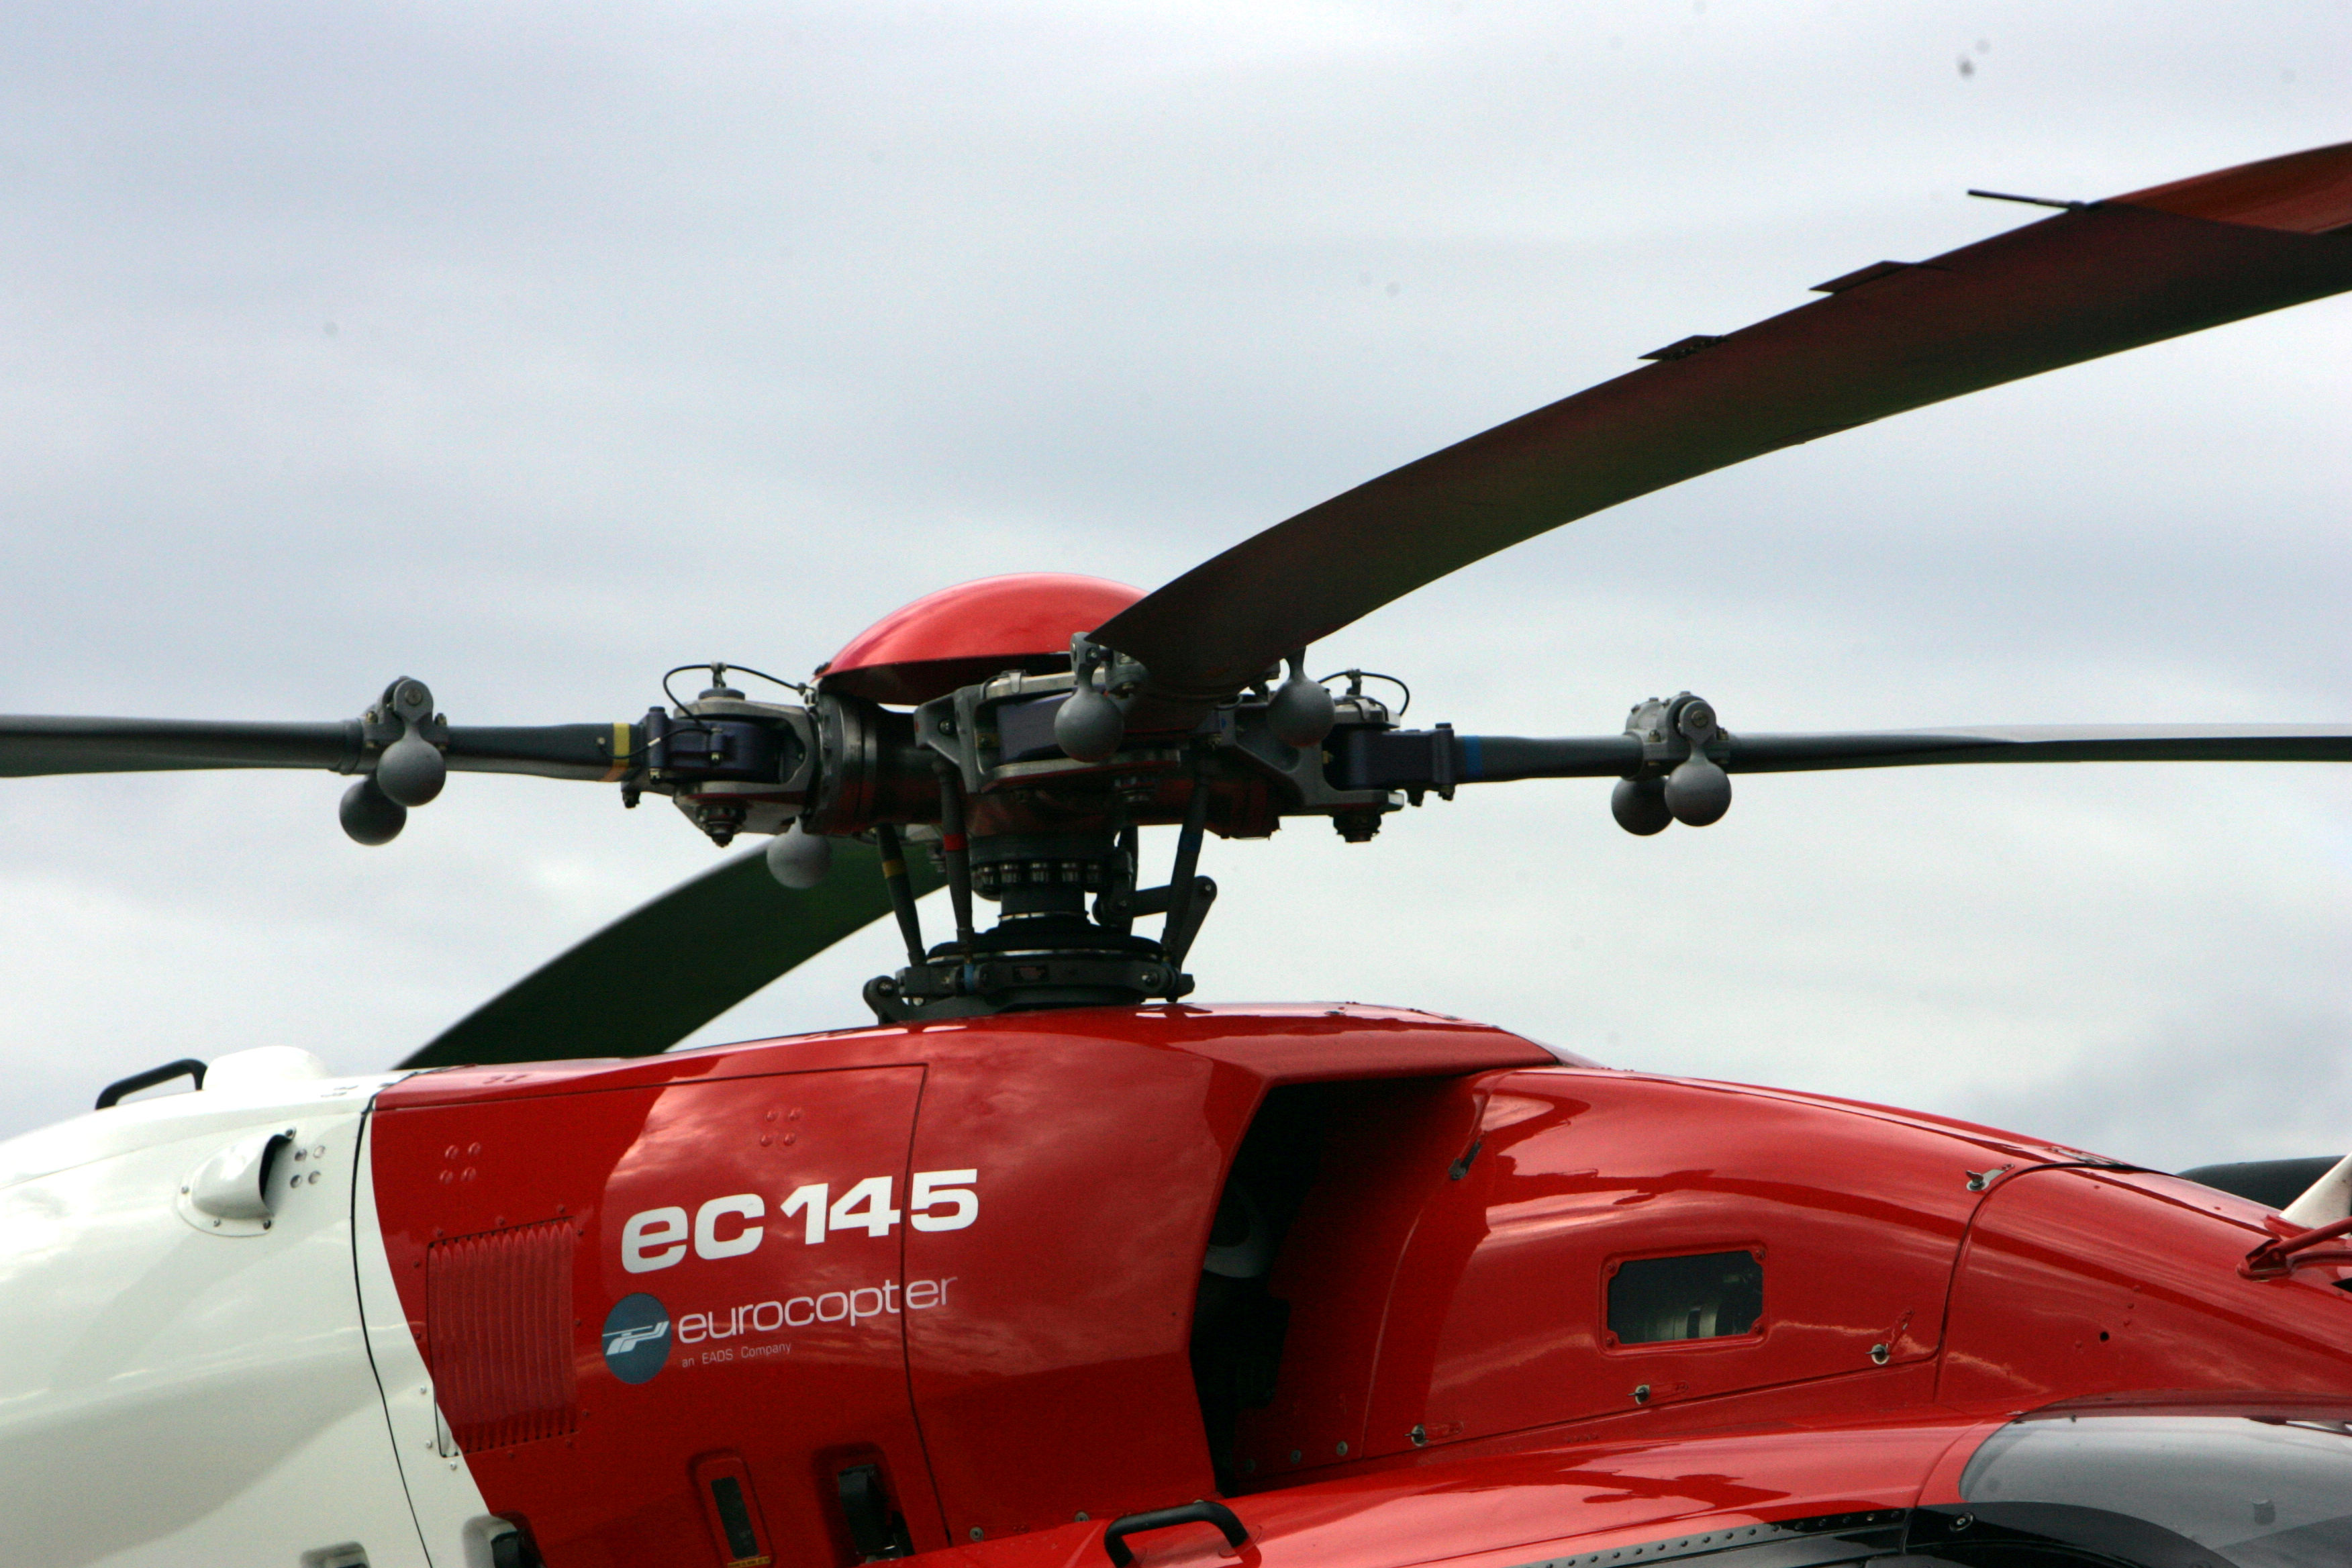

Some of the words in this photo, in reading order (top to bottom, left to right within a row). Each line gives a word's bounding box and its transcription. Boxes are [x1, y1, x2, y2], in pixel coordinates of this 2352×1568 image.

[678, 1277, 958, 1343] eurocopter
[682, 1357, 695, 1368] an
[702, 1349, 733, 1365] EADS
[741, 1343, 791, 1359] Company
